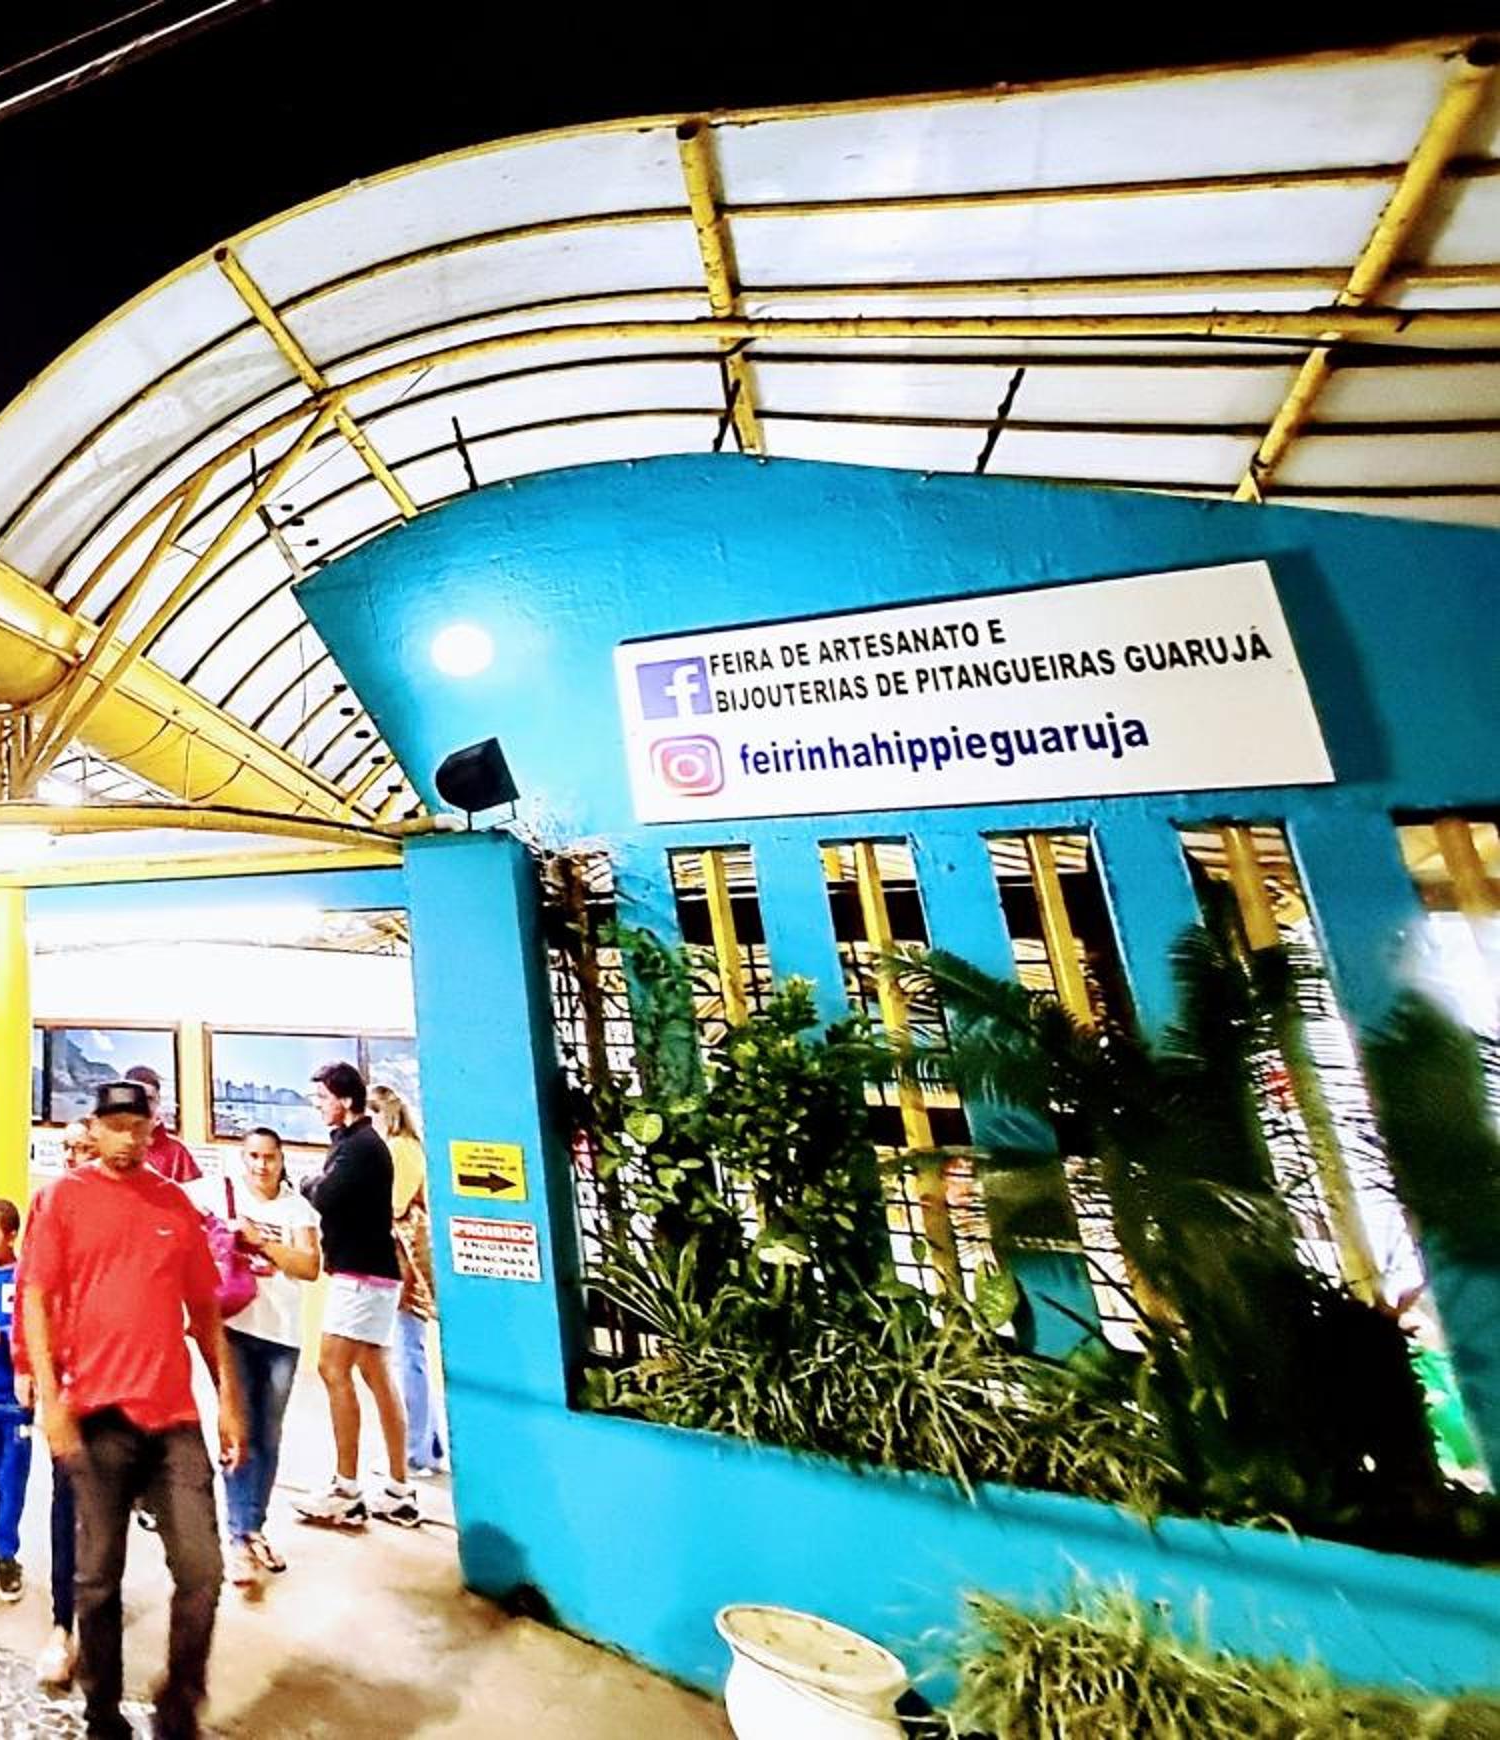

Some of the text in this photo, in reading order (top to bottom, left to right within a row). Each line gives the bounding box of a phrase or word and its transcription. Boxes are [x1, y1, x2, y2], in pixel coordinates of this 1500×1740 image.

[709, 619, 1007, 676] FEIRA DE ARTESANATO E
[716, 625, 1273, 713] BIJOUTERIAS DE PITANGUEIRAS GUARUJÁ
[739, 711, 1150, 776] feirinhahippieguaruja
